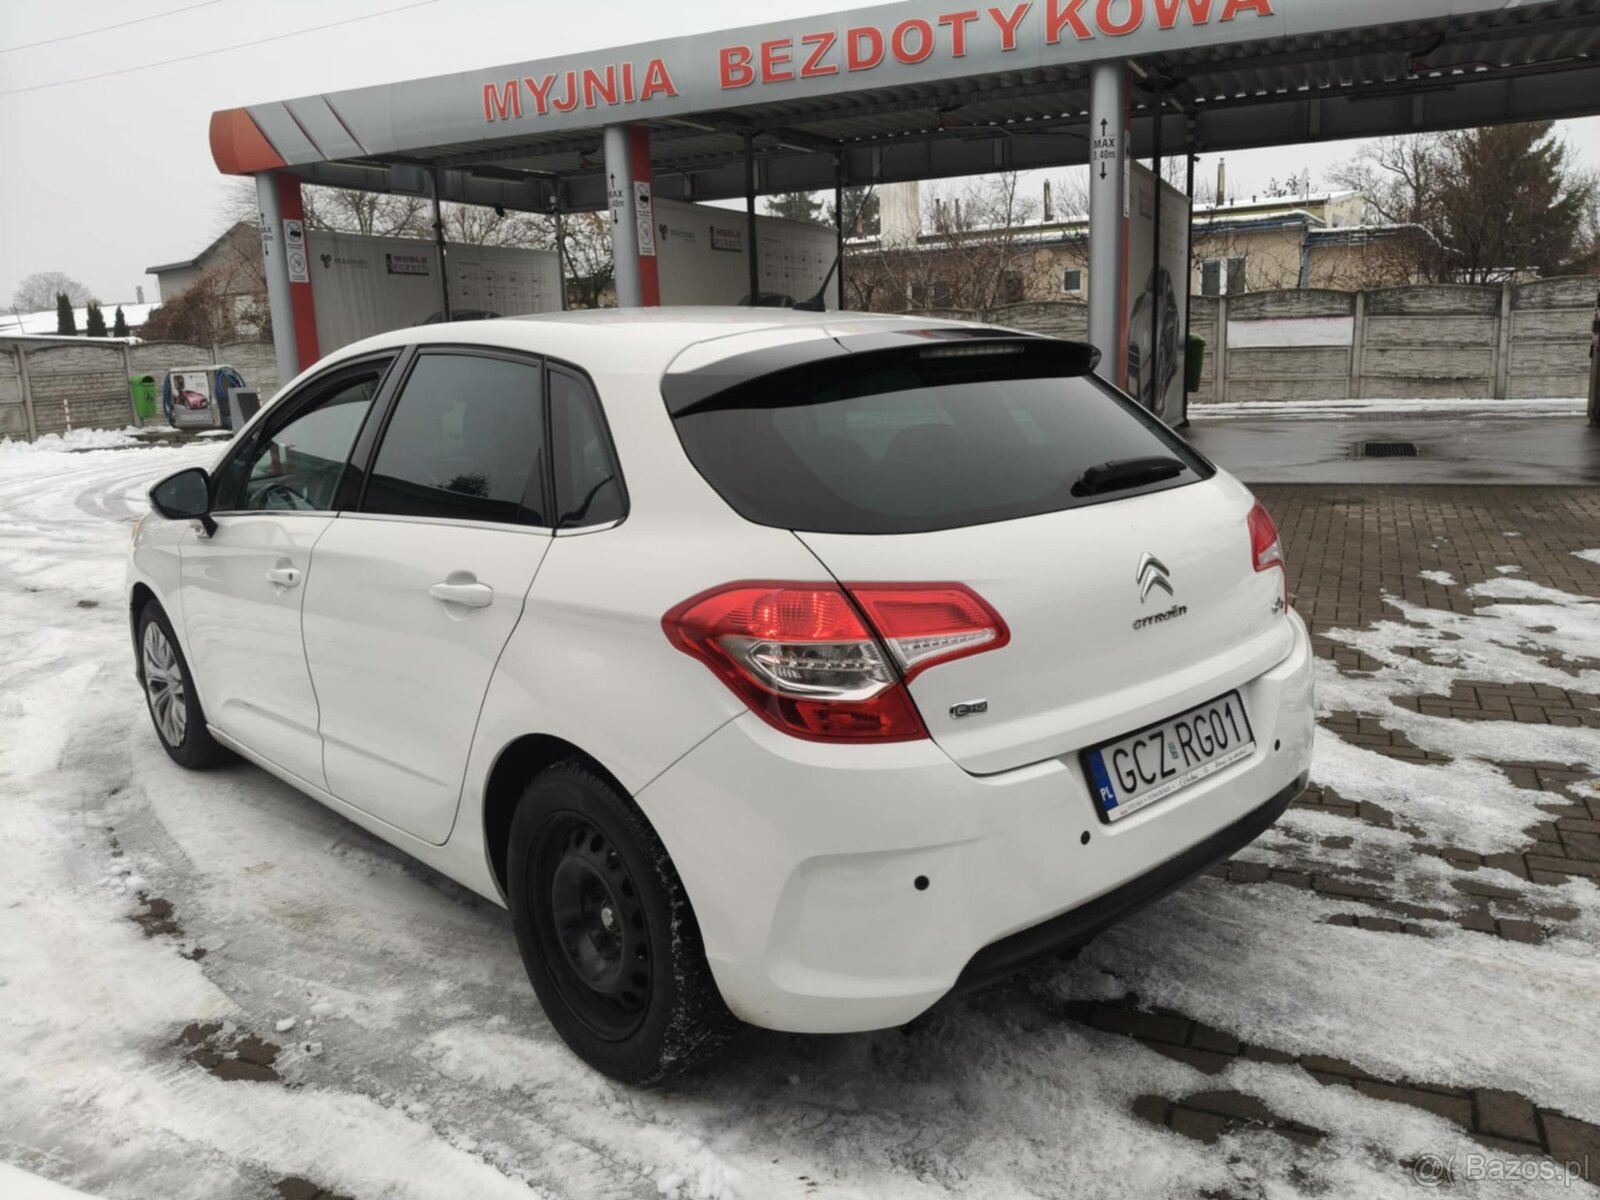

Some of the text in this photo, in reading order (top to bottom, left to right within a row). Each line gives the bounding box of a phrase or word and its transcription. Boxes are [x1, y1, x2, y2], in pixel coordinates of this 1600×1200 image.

[483, 57, 679, 122] MYJNIA
[1093, 138, 1116, 149] MAX
[1113, 702, 1241, 793] GCZ RG01
[1100, 787, 1114, 801] PL
